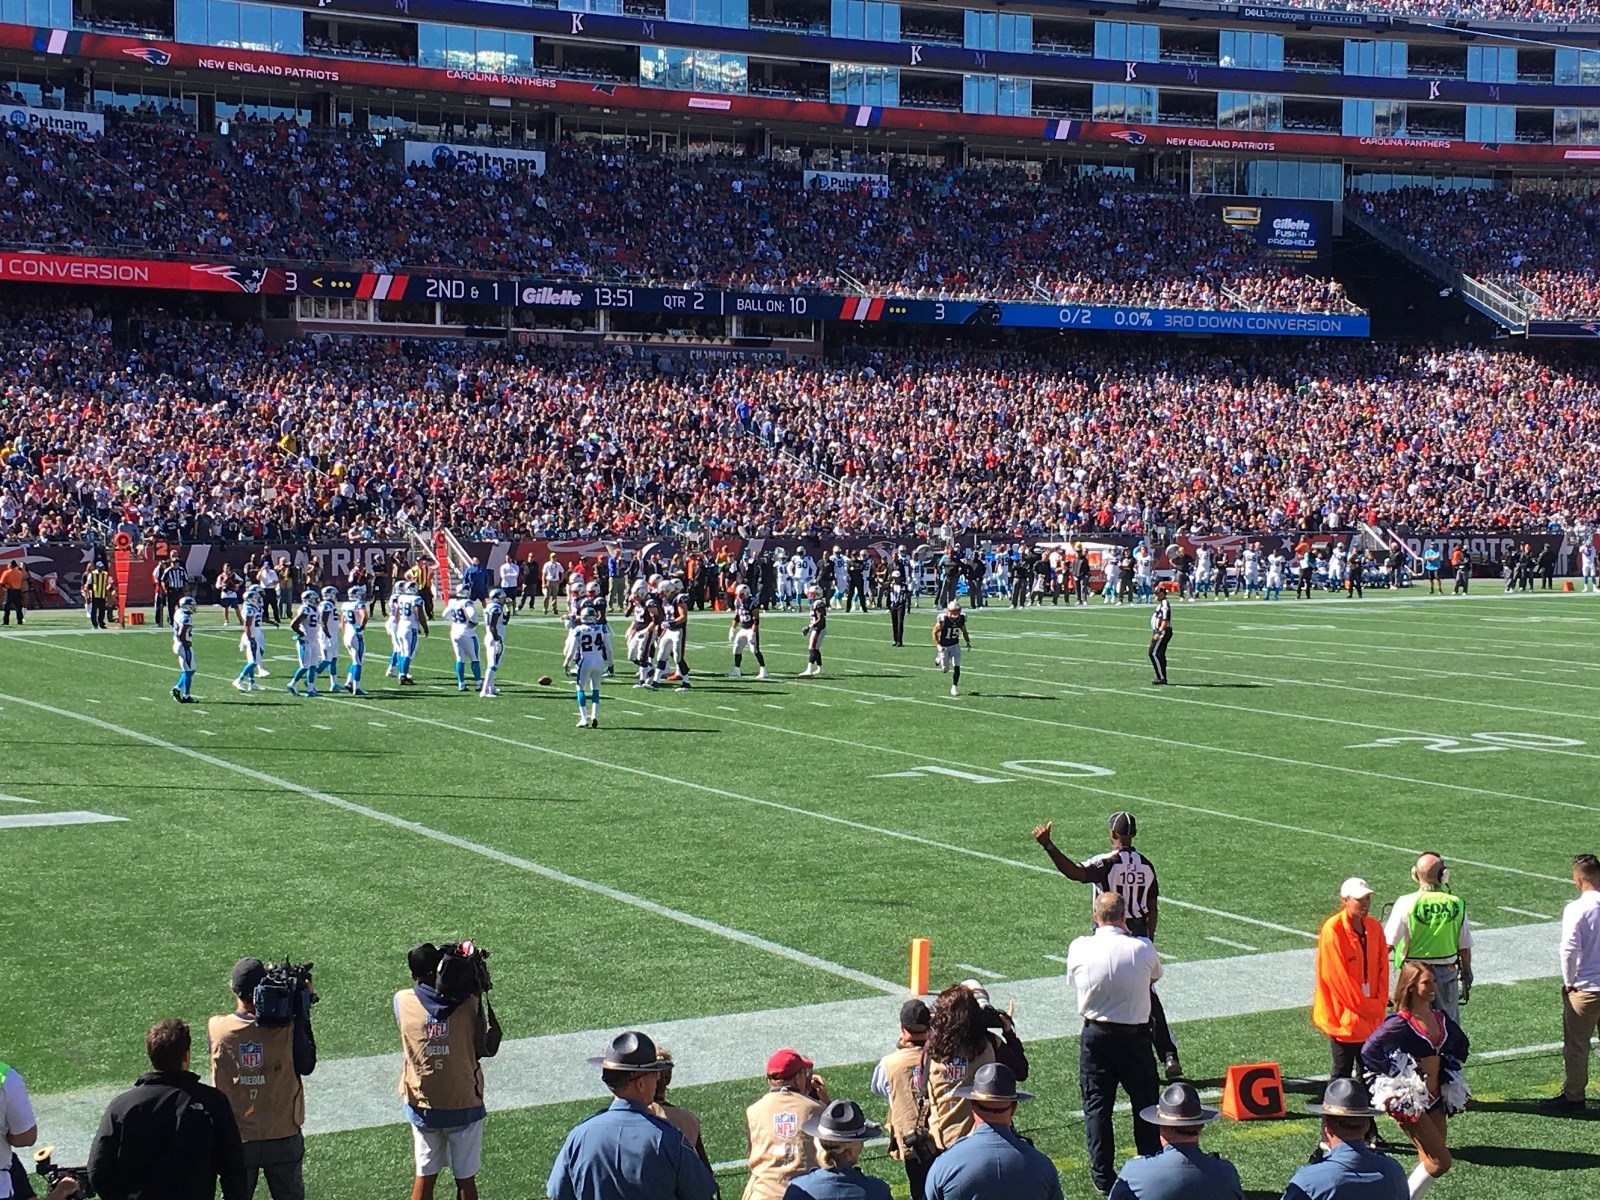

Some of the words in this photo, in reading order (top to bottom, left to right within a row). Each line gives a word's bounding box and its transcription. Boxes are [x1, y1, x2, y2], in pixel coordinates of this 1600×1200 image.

[570, 13, 584, 34] K
[641, 21, 656, 39] M
[910, 45, 923, 65] K
[974, 52, 987, 68] M
[198, 58, 225, 69] NEW
[227, 61, 282, 75] ENGLAND
[284, 67, 340, 81] PATRIOTS
[1125, 62, 1137, 81] K
[1186, 68, 1198, 84] M
[446, 70, 500, 84] CAROLINA
[501, 75, 557, 88] PANTHERS
[1428, 80, 1441, 99] K
[1488, 85, 1501, 100] M
[29, 113, 89, 131] Putnam
[1165, 136, 1186, 146] NEW
[1187, 138, 1231, 149] ENGLAND
[1231, 141, 1275, 151] PATRIOTS
[1359, 136, 1403, 147] CAROLINA
[1404, 139, 1451, 149] PANTHERS
[1272, 217, 1311, 231] Gillette
[9, 258, 149, 282] CONVERSION
[284, 271, 298, 291] 3
[426, 278, 465, 298] 2ND
[470, 286, 480, 299] &
[492, 282, 499, 300] 1
[522, 287, 582, 306] Gillette
[594, 287, 634, 308] 13:51
[663, 294, 686, 309] QTR
[693, 292, 705, 310] 2
[736, 298, 764, 312] BALL
[766, 301, 785, 313] ON:
[789, 296, 807, 315] 10
[935, 303, 945, 320] 3
[1059, 308, 1092, 324] 0/2
[1114, 311, 1153, 328] 0.0%
[1164, 314, 1195, 328] 3RD
[1199, 316, 1245, 329] DOWN
[1246, 318, 1342, 332] CONVERSION
[271, 548, 412, 578] PATRIOT
[581, 633, 603, 652] 24
[1119, 872, 1146, 885] 103
[1423, 902, 1451, 917] FOX
[428, 1024, 447, 1037] NFL
[426, 1046, 450, 1055] MEDIA
[242, 1053, 261, 1067] NFL
[240, 1075, 266, 1085] MEDIA
[947, 1066, 965, 1080] NFL
[1238, 1068, 1283, 1116] G
[776, 1122, 795, 1136] NFL
